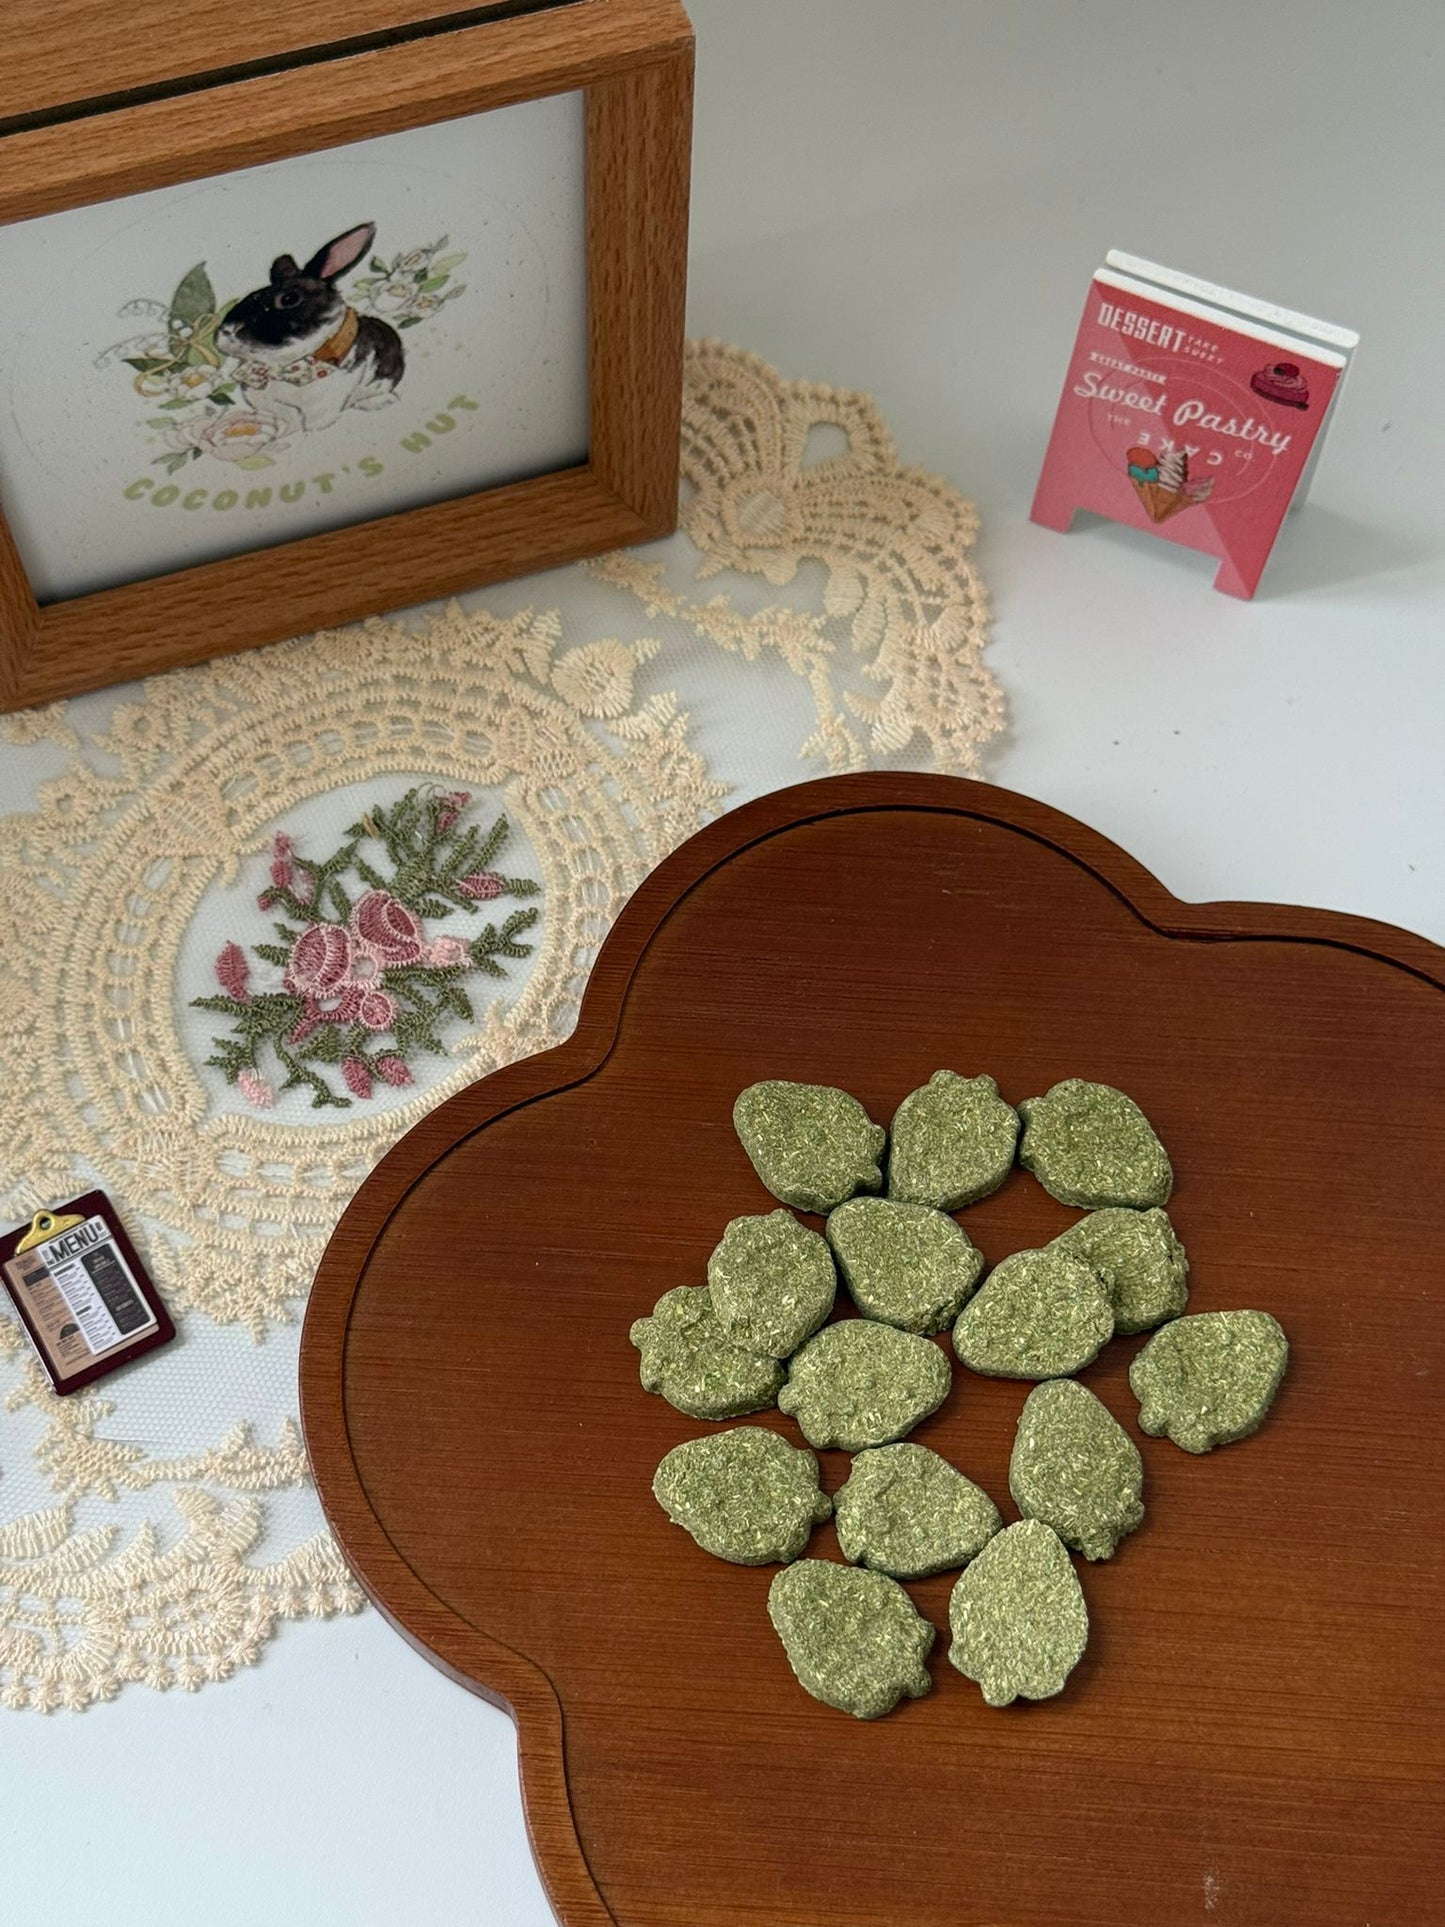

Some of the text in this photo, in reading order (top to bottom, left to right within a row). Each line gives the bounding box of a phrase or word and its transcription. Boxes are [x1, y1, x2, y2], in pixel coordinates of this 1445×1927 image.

[1097, 302, 1187, 353] DESSERT
[1073, 371, 1293, 455] Sweet Pastry
[1105, 413, 1131, 426] THE
[122, 455, 385, 511] COCONUT'S
[49, 1224, 99, 1263] MENU
